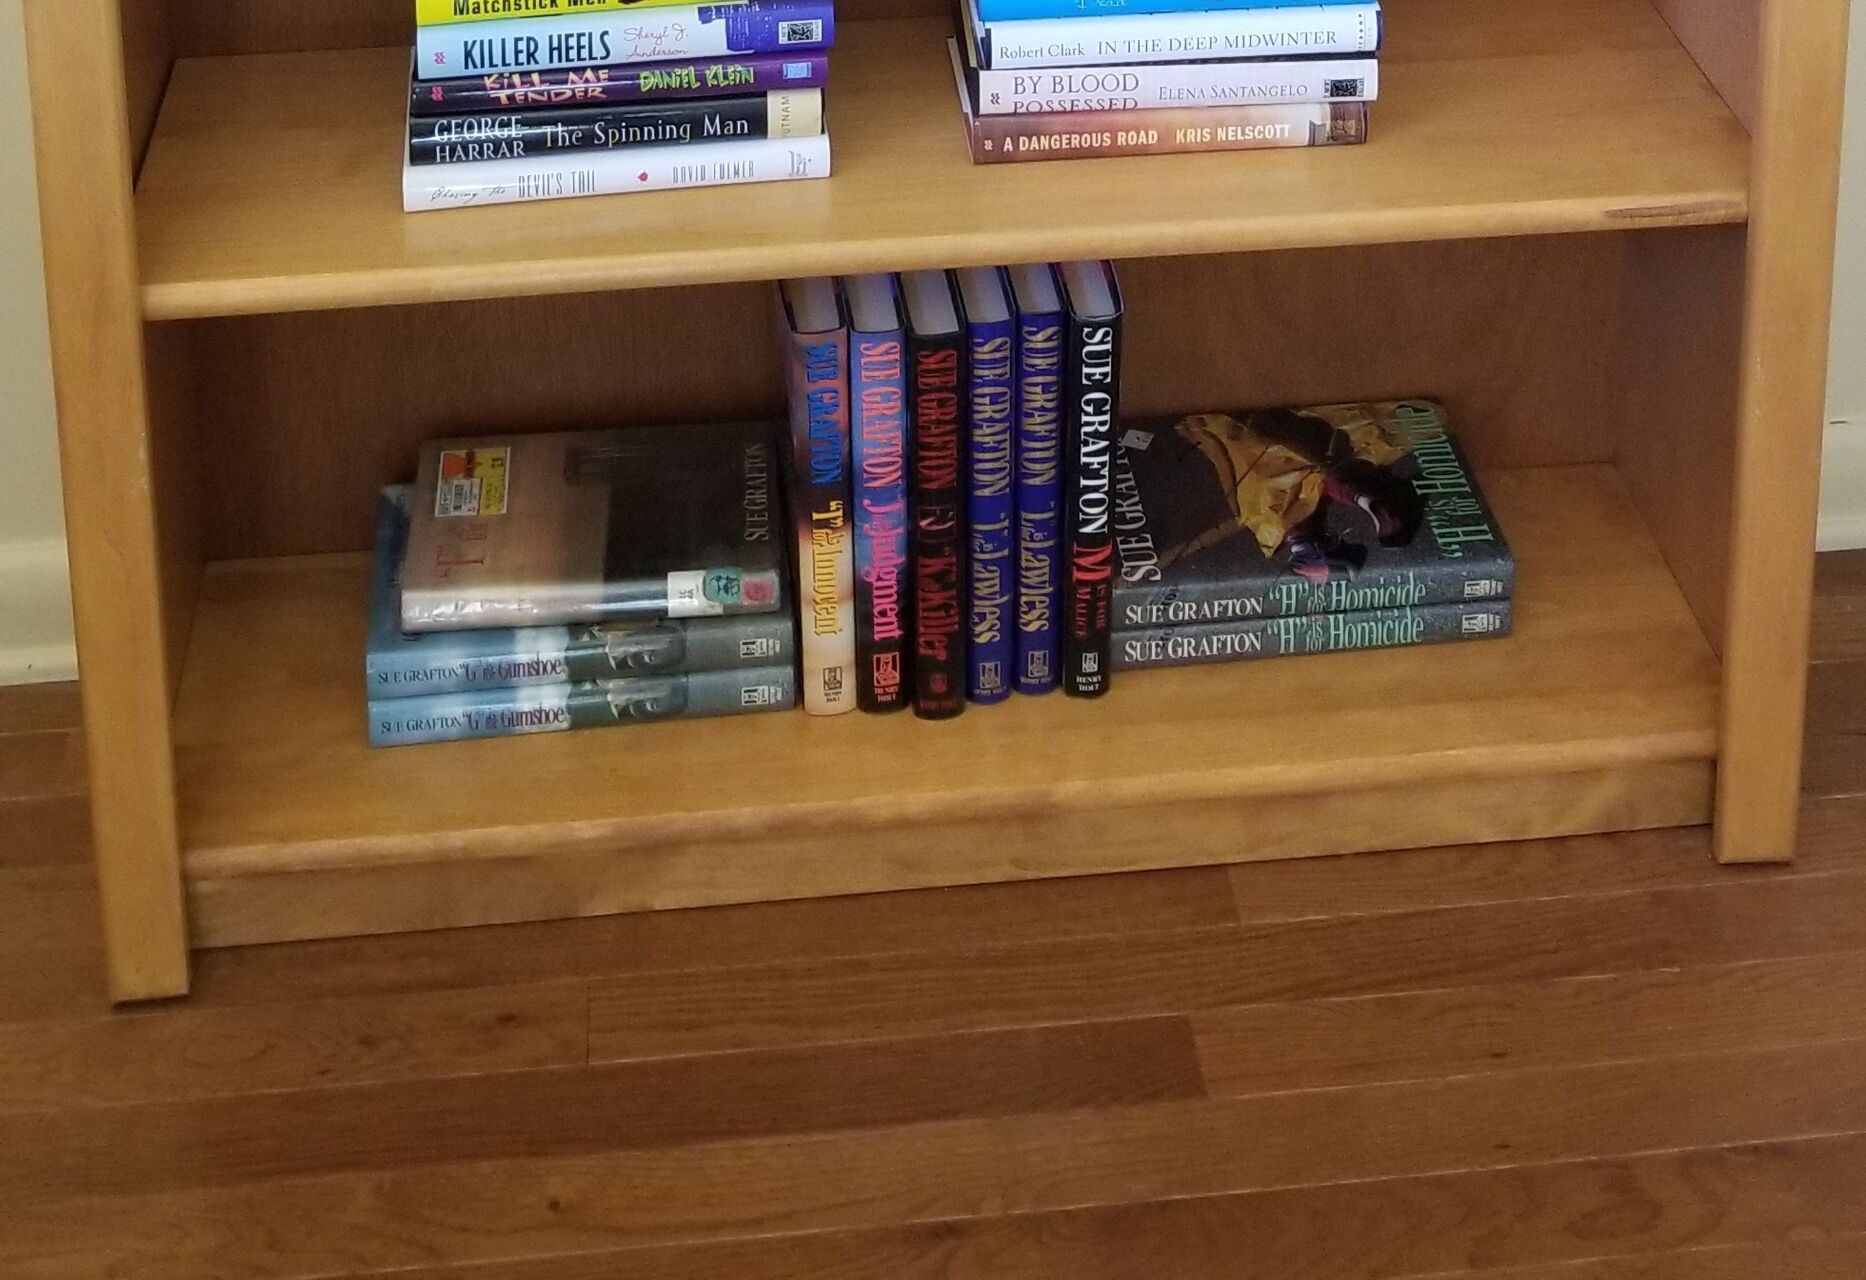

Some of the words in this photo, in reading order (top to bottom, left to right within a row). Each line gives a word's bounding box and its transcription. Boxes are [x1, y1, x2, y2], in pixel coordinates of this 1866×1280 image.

[1000, 45, 1043, 59] Robert
[1047, 43, 1085, 57] Clark
[1098, 42, 1117, 56] IN
[1122, 38, 1162, 54] THE
[1169, 36, 1217, 52] DEEP
[1222, 30, 1337, 50] MIDWINTER
[489, 88, 607, 105] TENDER
[1013, 76, 1042, 95] BY
[1051, 73, 1139, 93] BLOOD
[1159, 85, 1207, 101] ELENA
[1210, 82, 1308, 99] SANTANGELO
[1003, 137, 1013, 152] A
[1019, 132, 1111, 151] DANGEROUS
[1117, 130, 1158, 145] ROAD
[1176, 128, 1211, 144] KRIS
[1217, 124, 1291, 141] NELSCOTT
[673, 166, 705, 183] DAVID
[712, 161, 755, 180] FULMER
[805, 343, 838, 384] SUE
[860, 342, 900, 381] SUE
[917, 348, 957, 388] SUE
[973, 337, 1010, 384] SUE
[1022, 326, 1061, 373] SUE
[1082, 326, 1113, 385] SUE
[807, 388, 842, 484] GRAFTON
[861, 385, 900, 487] GRAFTON
[917, 392, 957, 489] GRAFTON
[974, 386, 1010, 496] GRAFTON
[1021, 376, 1061, 486] GRAFTON
[1078, 390, 1111, 534] GRAFTON
[1117, 534, 1161, 581] SUE
[1019, 540, 1054, 633] Lawless
